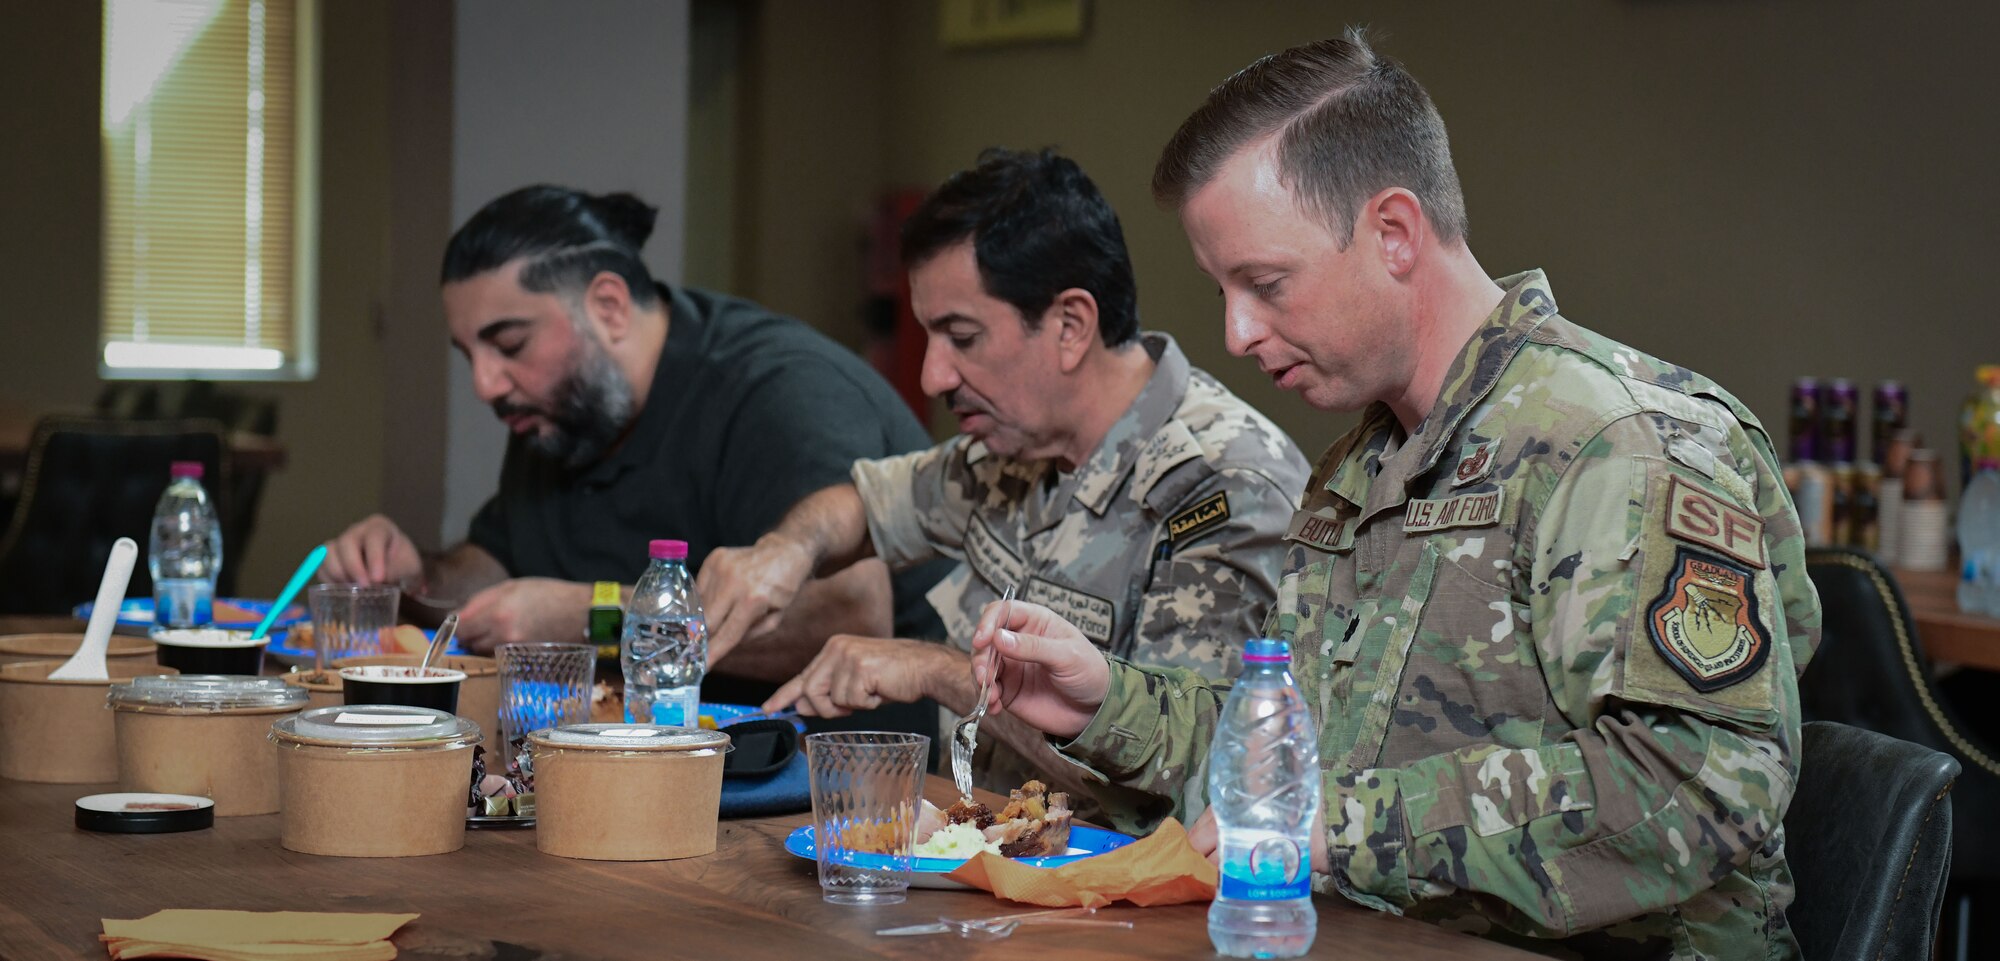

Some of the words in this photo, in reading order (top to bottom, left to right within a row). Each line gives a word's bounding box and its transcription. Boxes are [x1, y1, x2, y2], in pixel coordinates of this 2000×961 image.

[1405, 501, 1433, 527] U.S.
[1435, 499, 1460, 525] AIR
[1458, 494, 1498, 521] FORC
[1678, 494, 1756, 548] SF
[1080, 615, 1107, 637] Force
